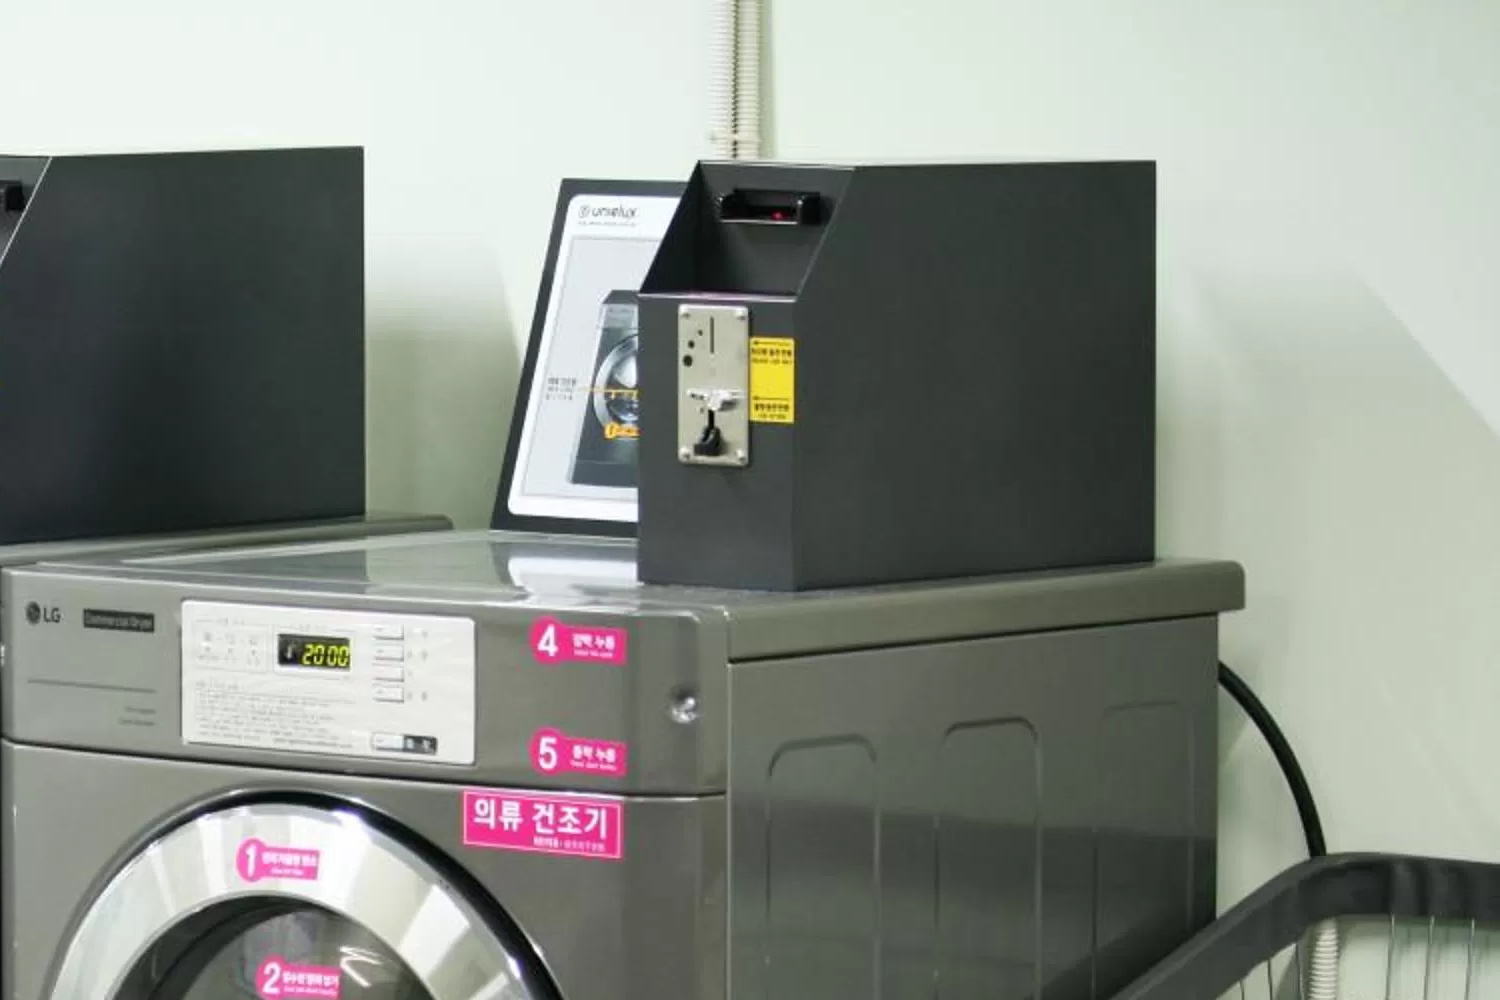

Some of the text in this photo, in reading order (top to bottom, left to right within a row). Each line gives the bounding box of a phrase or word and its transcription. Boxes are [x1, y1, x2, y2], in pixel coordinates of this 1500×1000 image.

[537, 623, 559, 657] 4
[538, 736, 558, 770] 5
[473, 797, 608, 840] 의류 건조기
[245, 844, 257, 878] 1
[262, 961, 281, 995] 2
